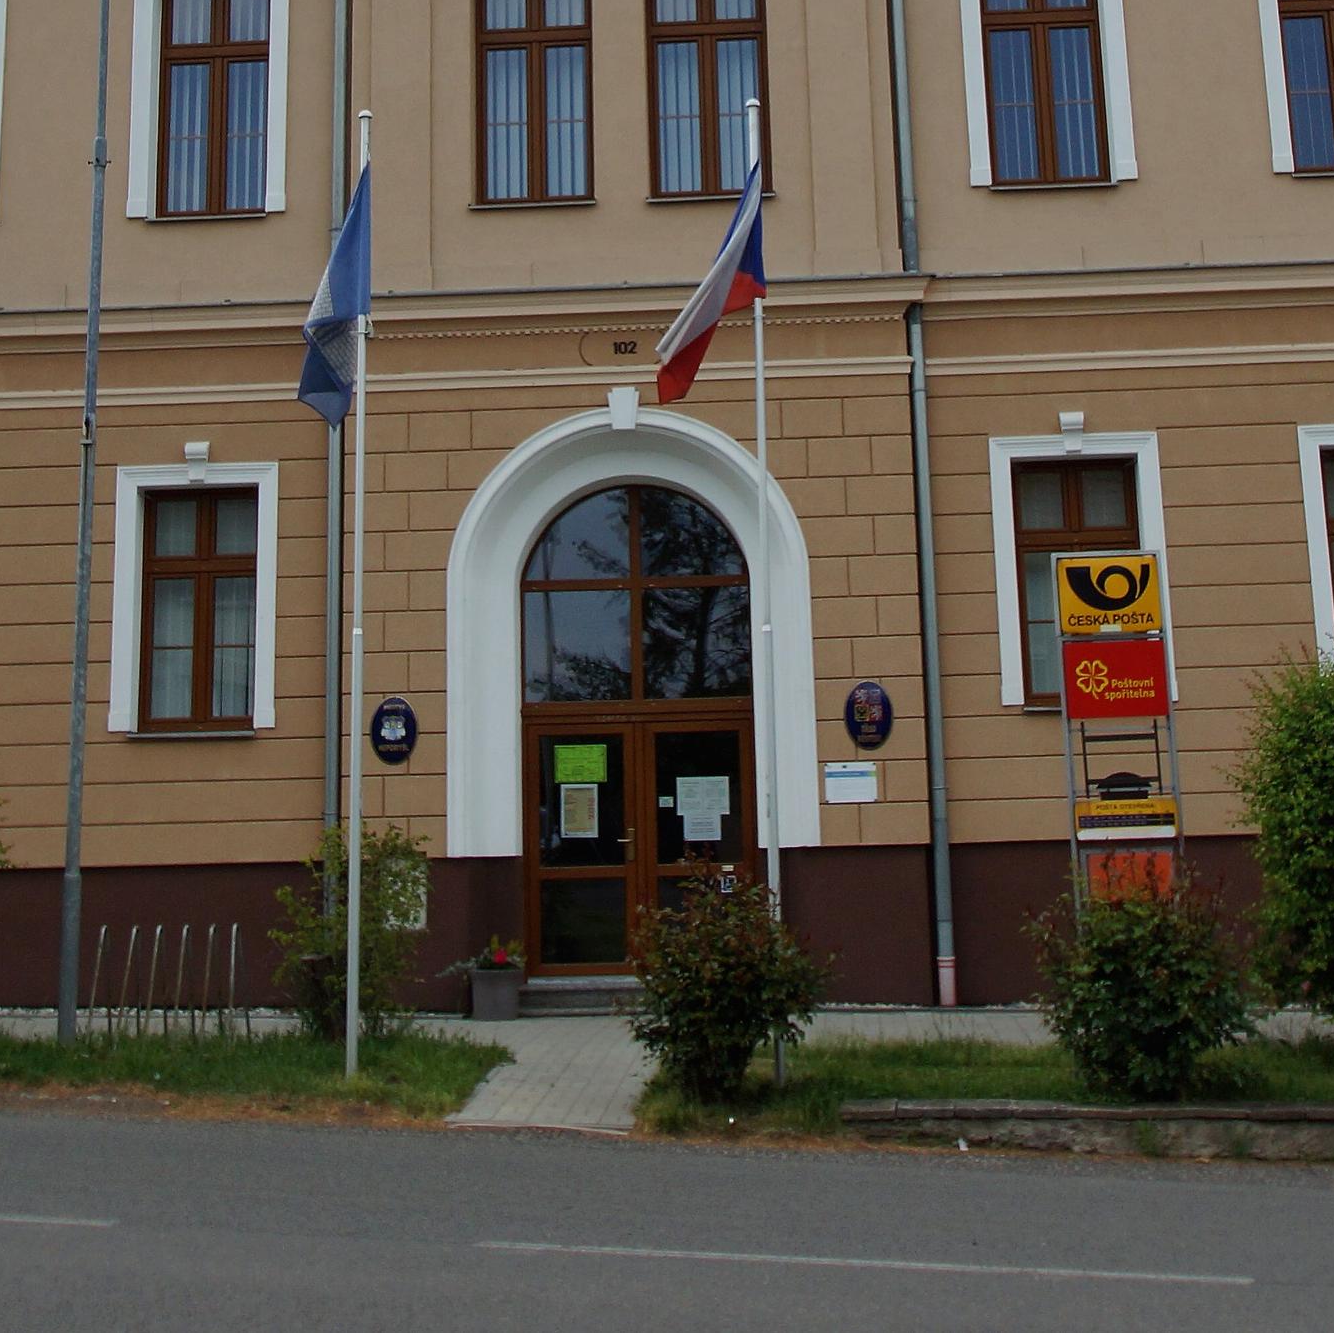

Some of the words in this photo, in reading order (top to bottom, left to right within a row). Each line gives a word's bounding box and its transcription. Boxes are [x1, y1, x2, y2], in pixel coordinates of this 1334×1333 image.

[613, 341, 637, 354] 102
[1068, 613, 1109, 626] ČESKÁ
[1113, 611, 1154, 624] POŠTA
[1111, 677, 1154, 688] Poštovní
[1104, 688, 1155, 701] spořitelna
